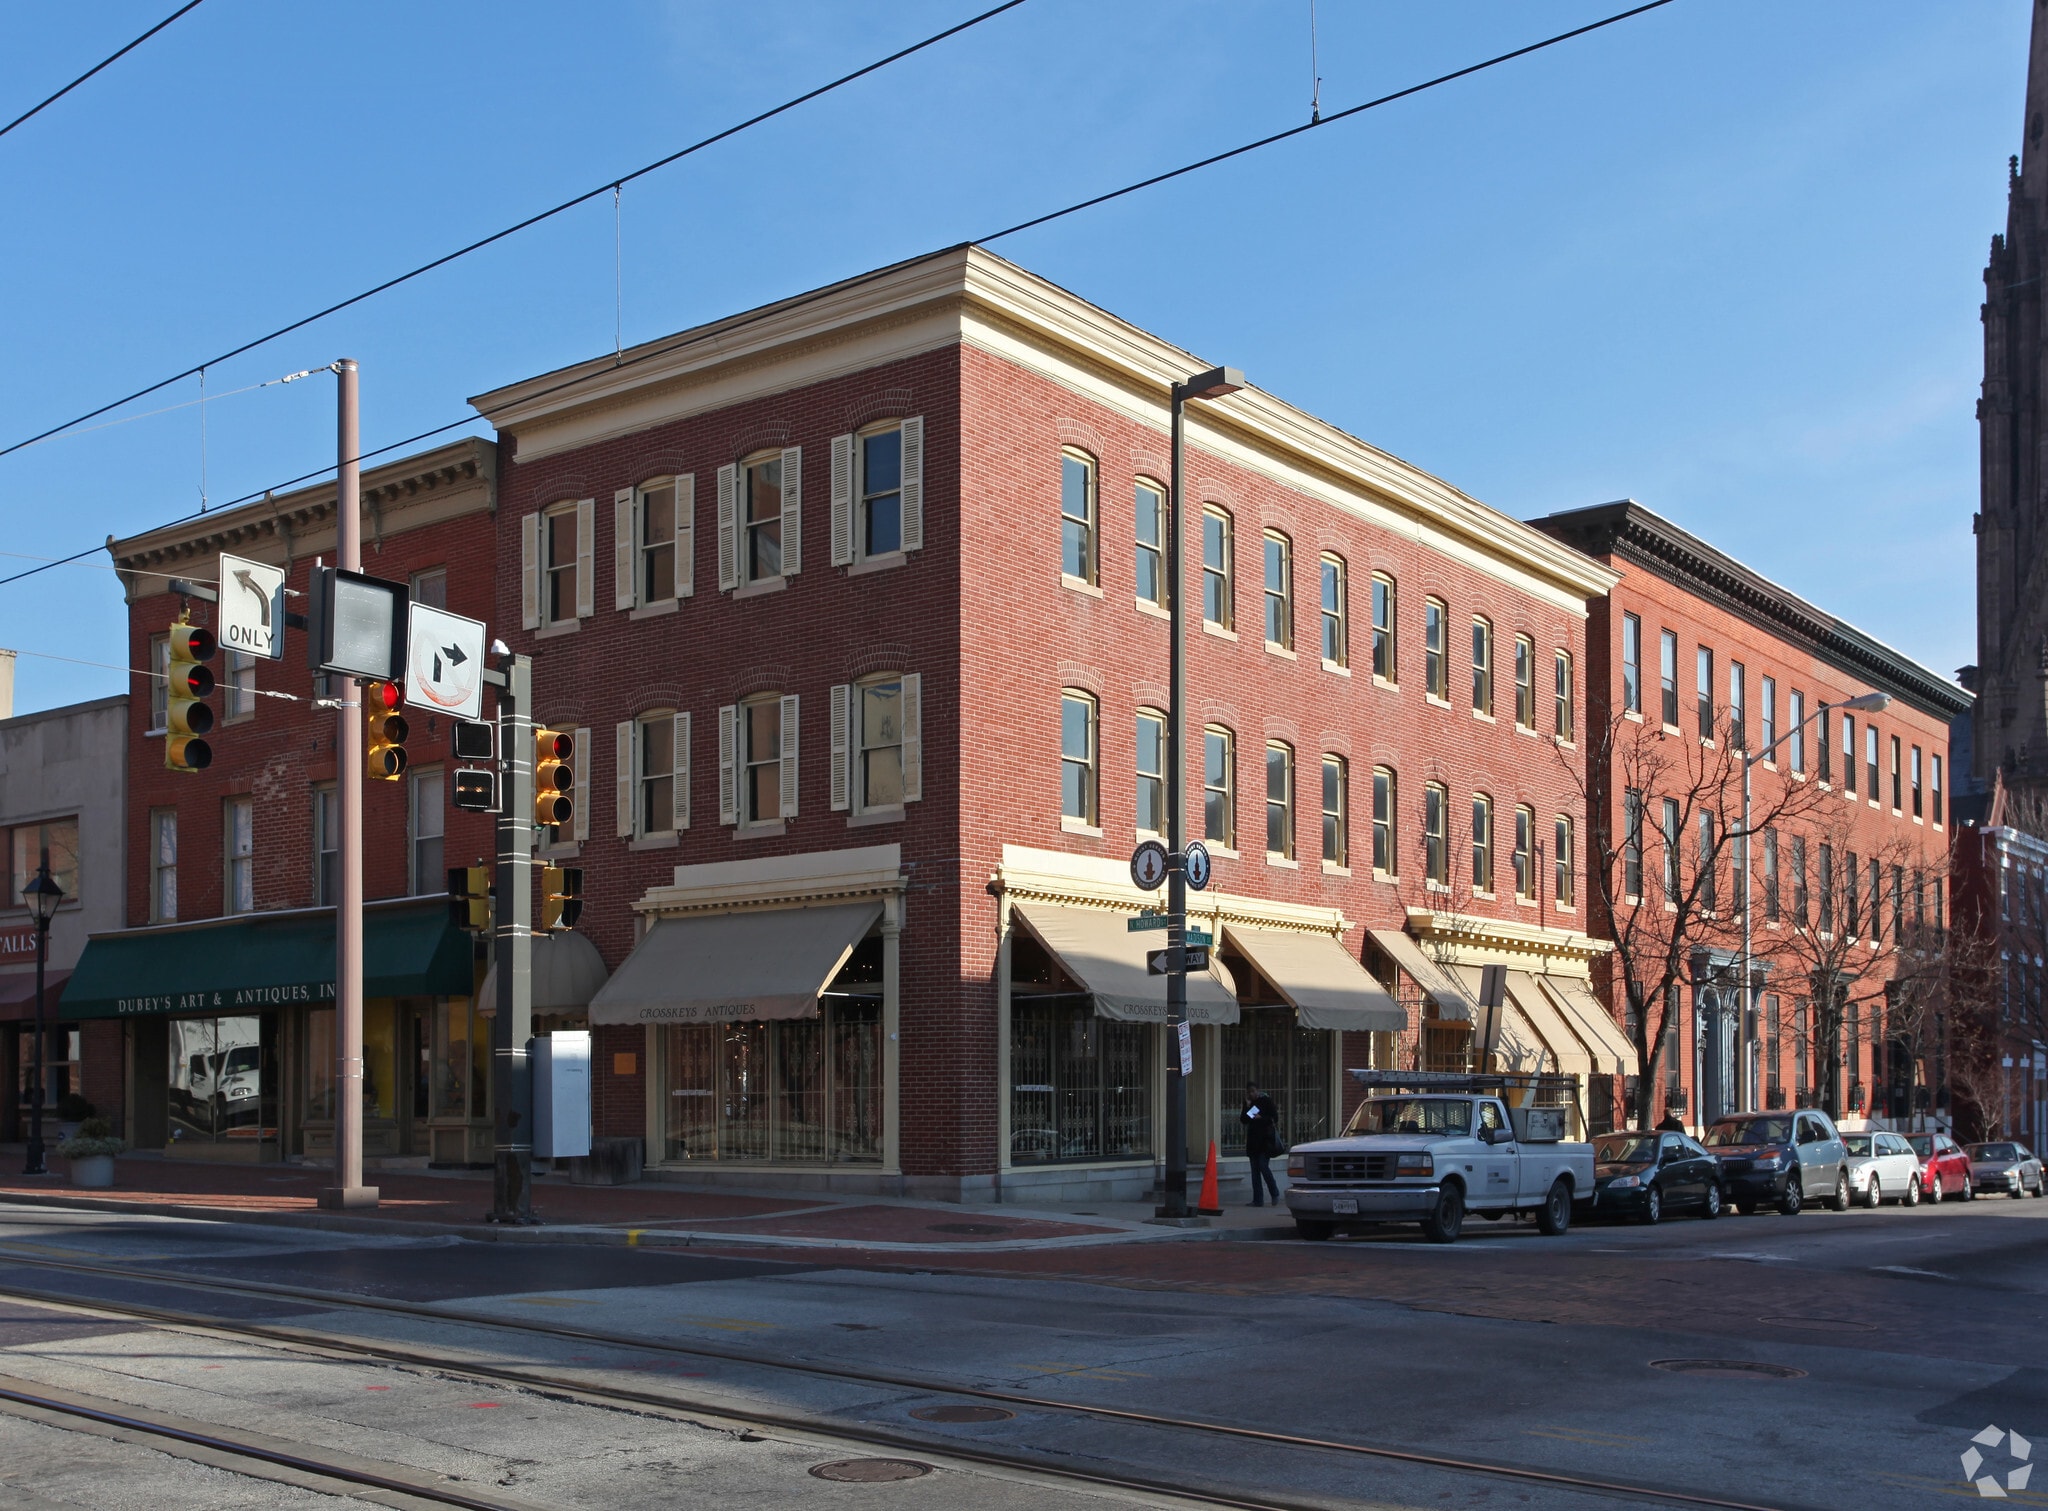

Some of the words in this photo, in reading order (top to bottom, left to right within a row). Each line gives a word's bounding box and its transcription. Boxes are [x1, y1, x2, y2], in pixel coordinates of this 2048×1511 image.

[229, 624, 275, 650] ONLY
[1136, 918, 1160, 929] HOWARD
[1186, 952, 1202, 965] WAY
[118, 996, 171, 1012] DUBEY'S
[180, 994, 204, 1008] ART
[213, 992, 222, 1006] &
[235, 985, 310, 1004] ANTIQUES,
[319, 983, 336, 998] IN
[640, 1006, 698, 1018] CROSSKEYS
[704, 1004, 756, 1017] ANTIQUES
[1123, 1004, 1167, 1016] CROSSKEYS
[1187, 1007, 1210, 1019] IQUES
